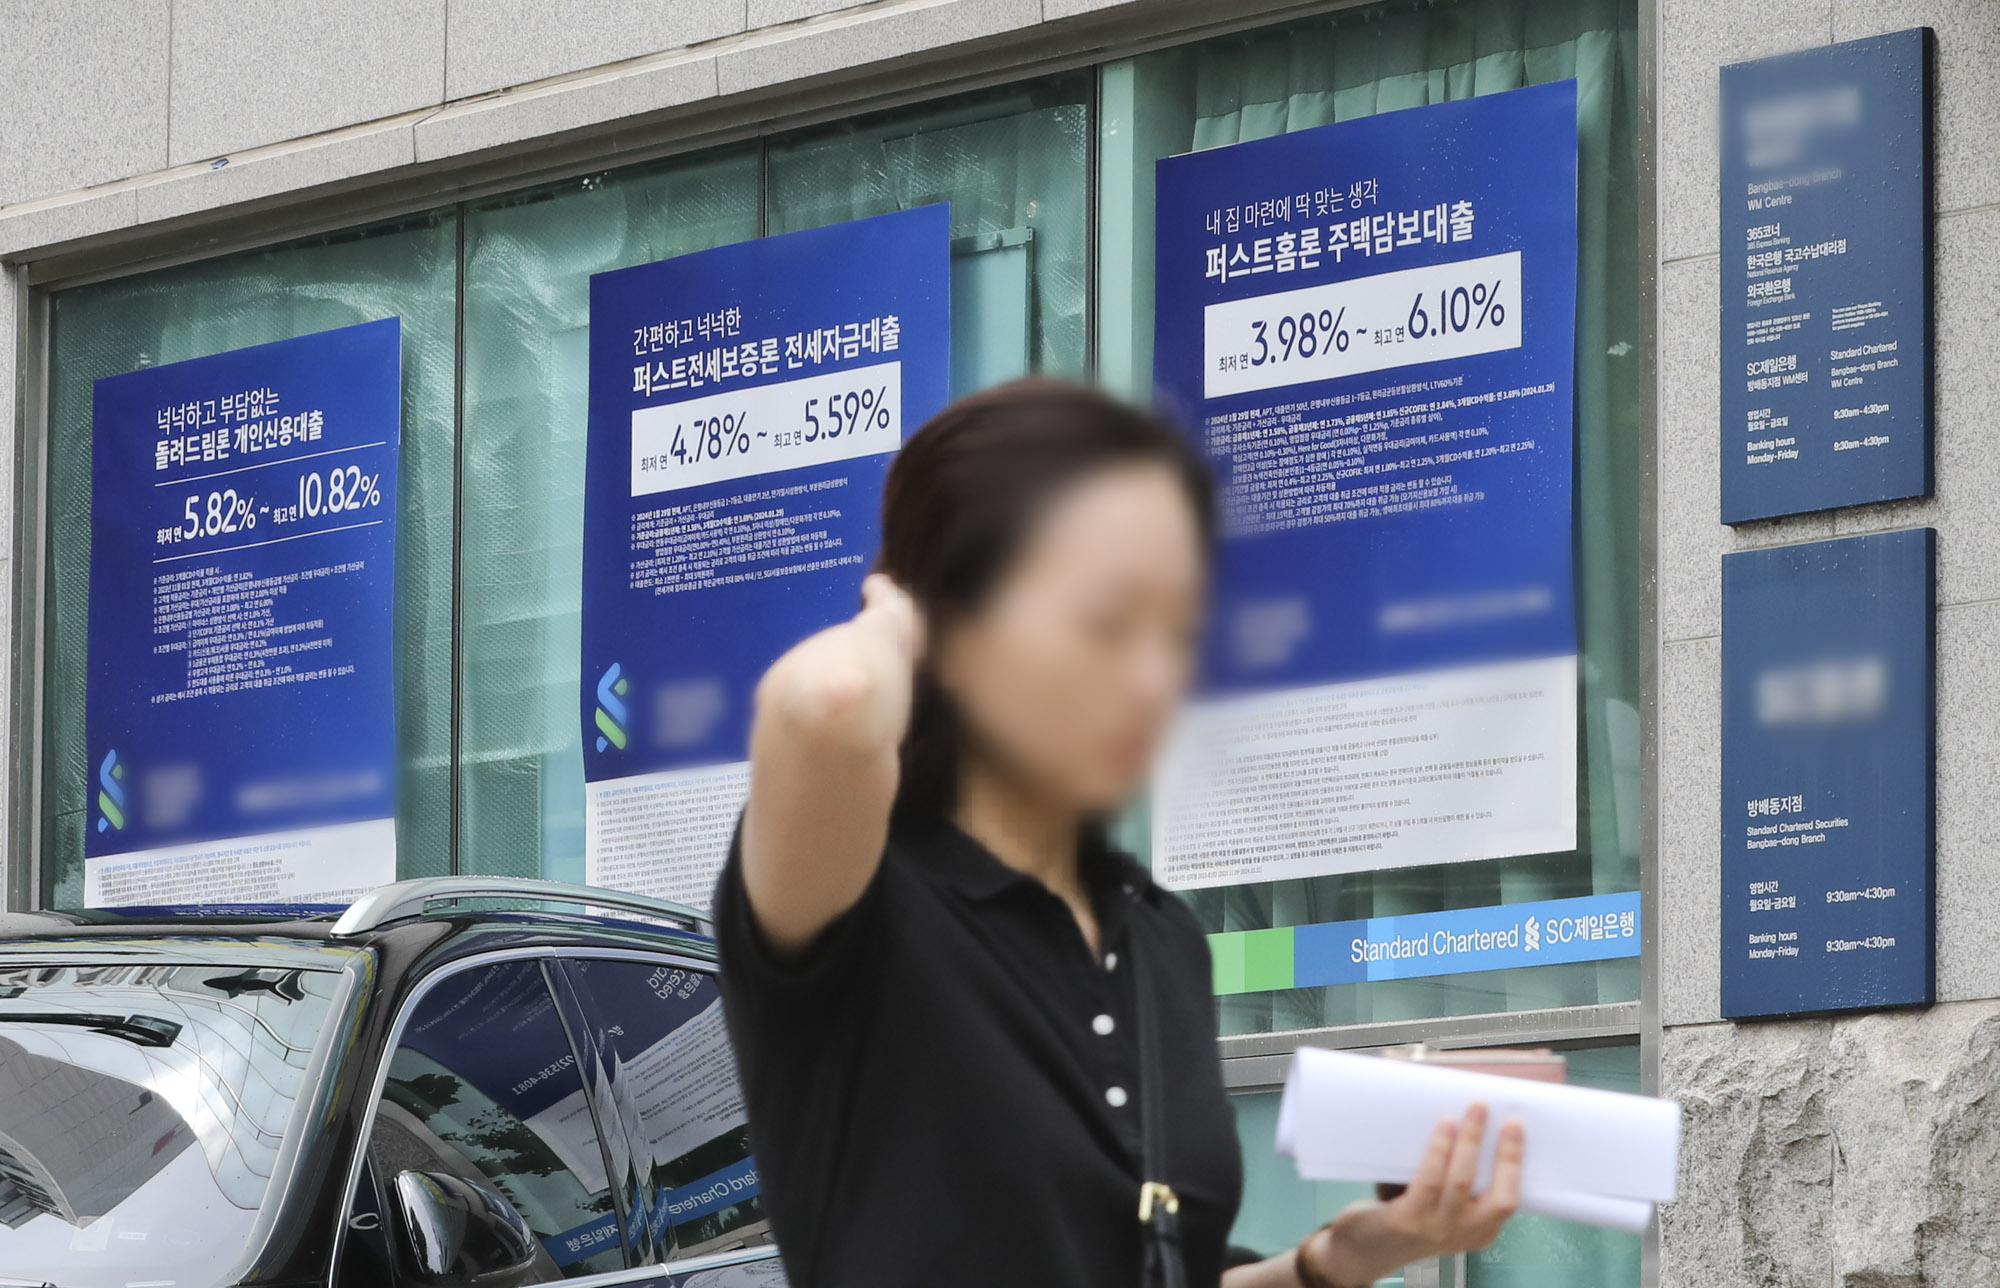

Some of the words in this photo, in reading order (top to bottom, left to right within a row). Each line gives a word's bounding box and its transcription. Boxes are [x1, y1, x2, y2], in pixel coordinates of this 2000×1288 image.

[1206, 208, 1221, 236] 내
[1225, 206, 1240, 233] 집
[1245, 196, 1291, 228] 마련에
[1295, 193, 1311, 219] 딱
[1315, 187, 1344, 216] 맞는
[1348, 178, 1378, 209] 생각
[1747, 198, 1763, 211] WM
[1765, 194, 1792, 209] Centre
[1205, 227, 1322, 283] 퍼스트홈론
[1327, 200, 1475, 263] 주택담보대출
[1746, 222, 1781, 241] 365코너
[1746, 250, 1783, 270] 한국은행
[1784, 238, 1847, 263] 국고수납대리점
[1747, 278, 1791, 298] 외국환은행
[633, 319, 694, 356] 간편하고
[697, 306, 742, 342] 넉넉한
[1218, 354, 1237, 373] 최저
[1240, 352, 1249, 370] 연
[1250, 306, 1349, 366] 3.98%
[1373, 328, 1393, 347] 최고
[1395, 325, 1405, 344] 연
[1408, 280, 1505, 339] 6.10%
[632, 337, 780, 397] 퍼스트전세보증론
[784, 314, 900, 370] 전세자금대출
[1830, 346, 1862, 361] Standard
[1862, 340, 1898, 356] Chartered
[1746, 354, 1797, 377] SC제일은행
[1830, 362, 1876, 377] Bangbae-dong
[1877, 358, 1899, 369] Branch
[1747, 376, 1781, 392] 방배동지점
[1782, 371, 1809, 386] WM센터
[1830, 378, 1842, 389] WM
[1843, 376, 1863, 387] Centre
[157, 401, 217, 435] 넉넉하고
[220, 387, 280, 424] 부담없는
[1747, 408, 1771, 421] 영업시간
[640, 455, 658, 473] 최저
[659, 453, 668, 470] 연
[670, 411, 750, 465] 4.78%
[773, 432, 792, 448] 최고
[793, 429, 802, 446] 연
[805, 385, 890, 442] 5.59%
[155, 429, 231, 471] 돌려드림론
[233, 410, 324, 454] 개인신용대출
[1747, 438, 1775, 452] Banking
[1775, 436, 1796, 447] hours
[156, 527, 173, 545] 최저
[173, 525, 182, 543] 연
[183, 488, 256, 540] 5.82%
[273, 506, 288, 525] 최고
[288, 504, 297, 522] 연
[299, 465, 381, 519] 10.82%
[1747, 794, 1803, 818] 방배동지점
[1746, 824, 1778, 837] Standard
[1779, 820, 1813, 833] Chartered
[1815, 817, 1849, 830] Securities
[1746, 836, 1799, 850] Bangbae-dong
[1801, 832, 1826, 844] Branch
[1749, 880, 1779, 895] 영업시간
[1350, 931, 1428, 963] Standard
[1432, 924, 1518, 956] Chartered
[1545, 910, 1635, 945] SC제일은행
[1749, 932, 1776, 945] Banking
[1778, 931, 1798, 942] hours
